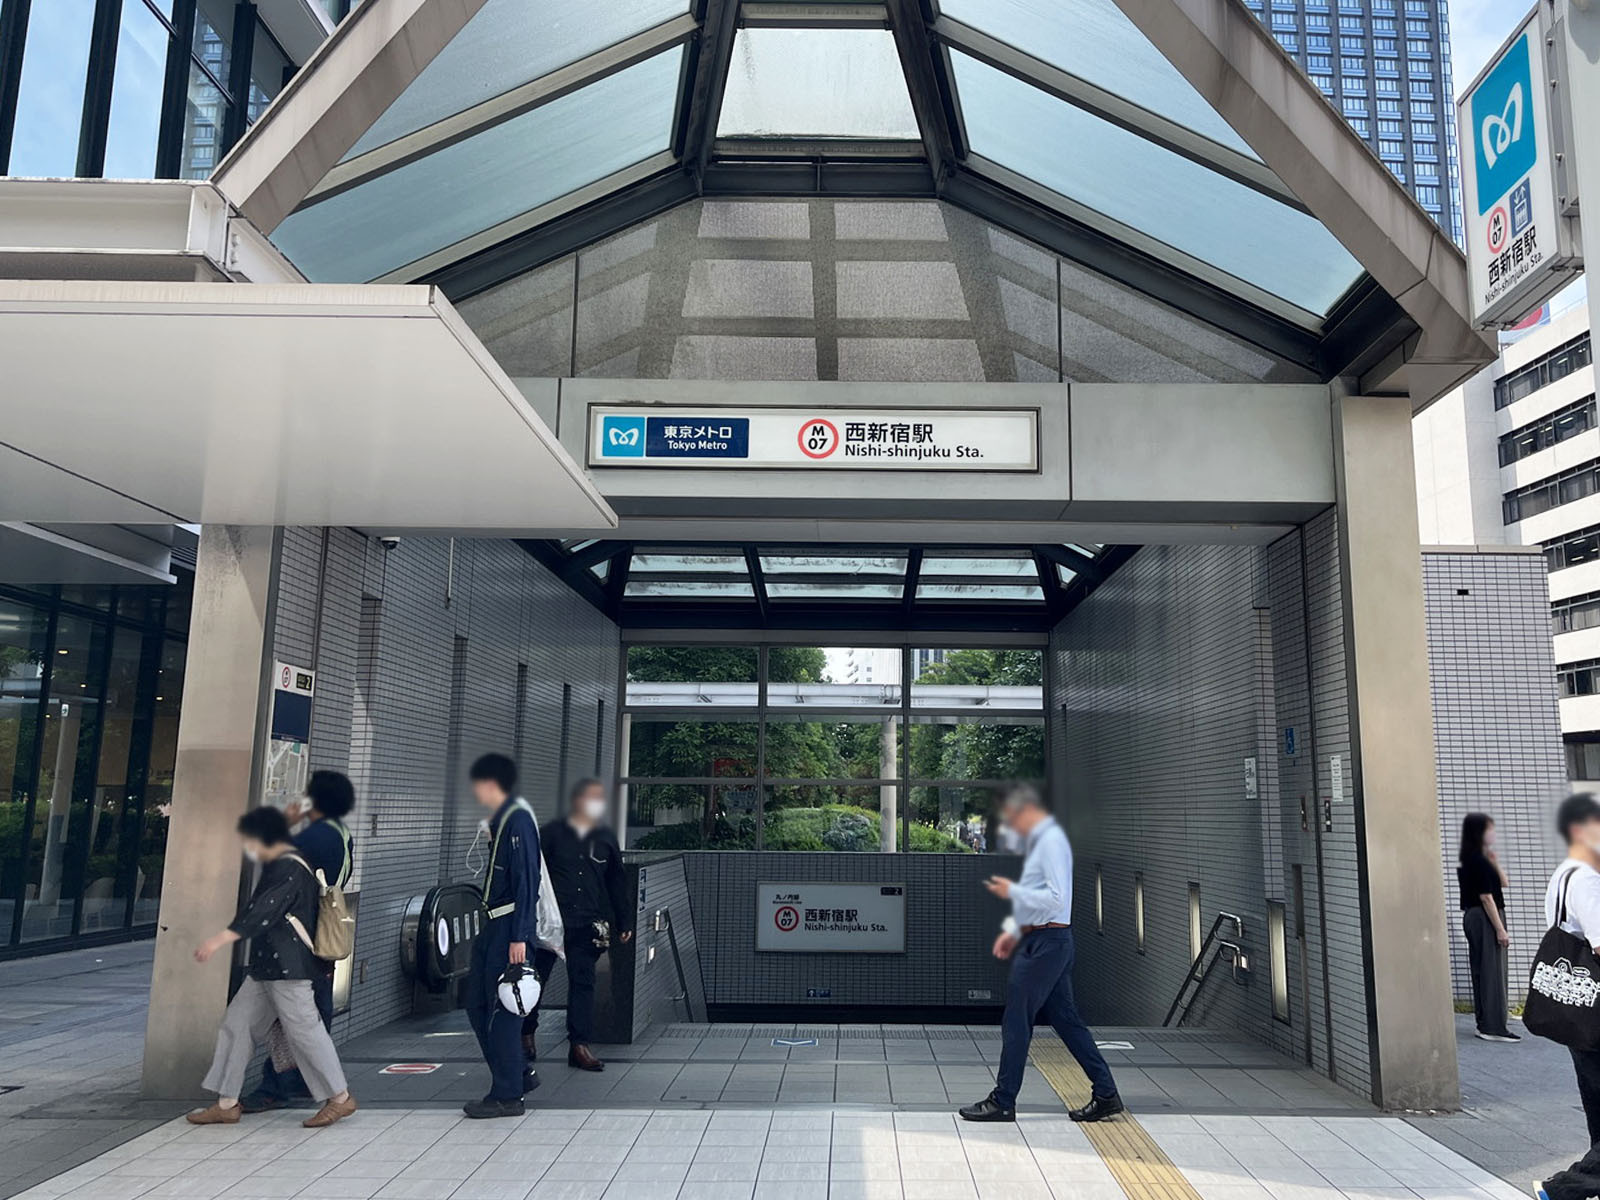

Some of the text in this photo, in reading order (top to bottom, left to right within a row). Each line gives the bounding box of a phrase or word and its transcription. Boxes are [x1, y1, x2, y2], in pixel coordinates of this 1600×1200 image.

[1493, 215, 1500, 229] M
[1492, 226, 1502, 245] 07
[1488, 225, 1537, 287] 西新宿駅
[1485, 252, 1544, 304] Nishi-shinjuku Sta.
[664, 425, 732, 439] 東京メトロ
[811, 426, 825, 436] M
[845, 422, 933, 443] 西新宿駅
[668, 440, 728, 451] Tokyo Metro
[808, 438, 828, 450] 07
[845, 444, 984, 460] Nishi-shinjuku Sta.
[306, 676, 311, 689] 2
[782, 910, 791, 918] M
[805, 909, 858, 922] 西新宿駅
[781, 918, 793, 926] 07
[804, 922, 888, 933] Nishi-shinjuku Sta.
